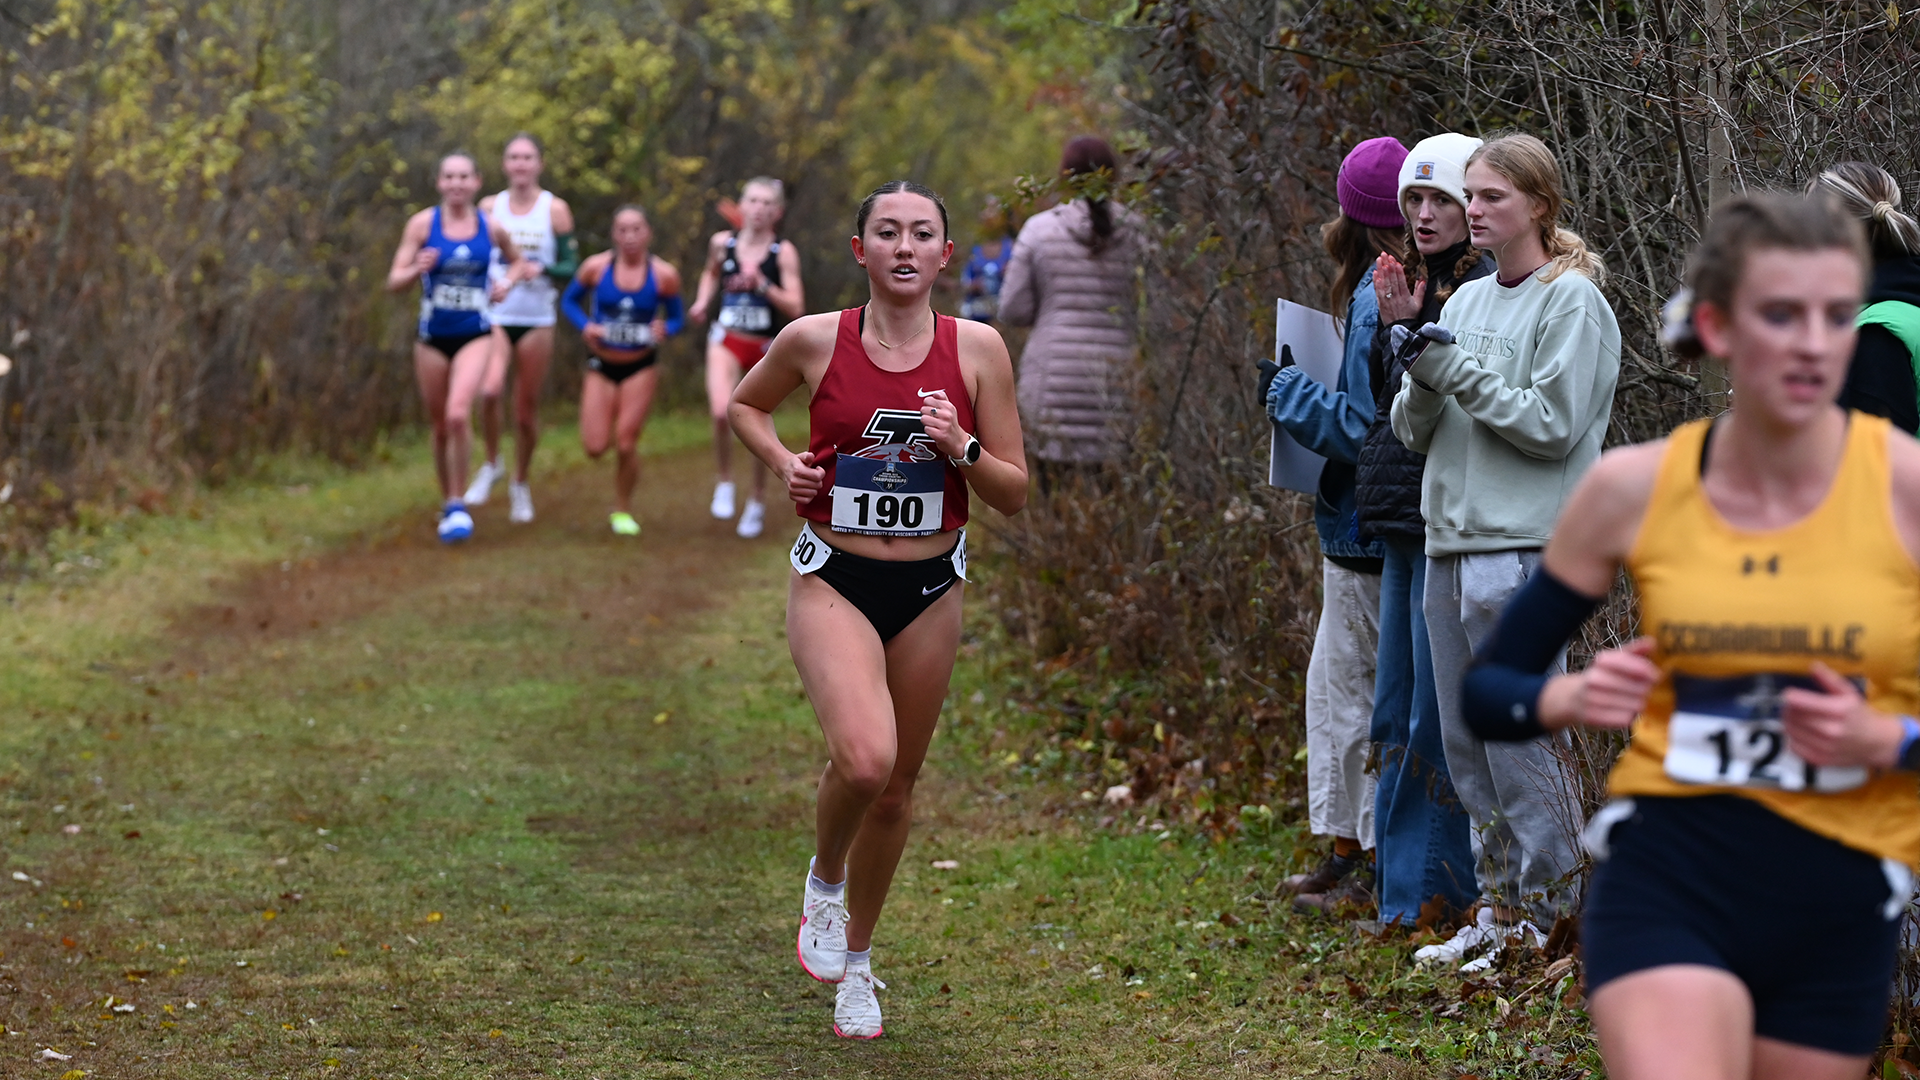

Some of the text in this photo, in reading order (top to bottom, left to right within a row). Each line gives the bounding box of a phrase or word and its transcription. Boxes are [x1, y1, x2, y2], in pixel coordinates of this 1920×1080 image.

[1454, 330, 1516, 359] OUNTAINS
[853, 493, 924, 528] 190
[1705, 726, 1817, 790] 12
